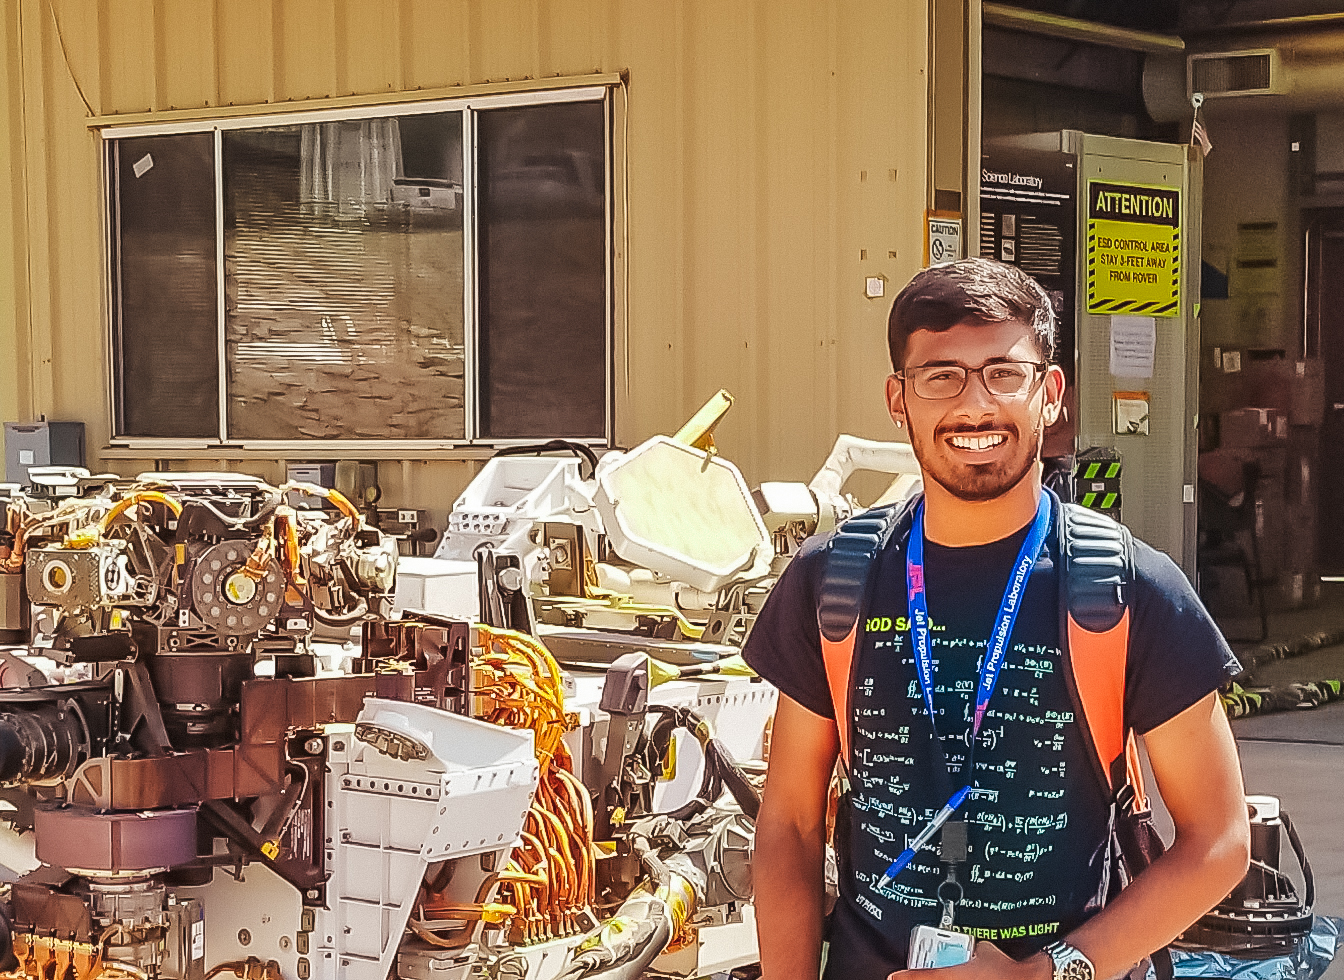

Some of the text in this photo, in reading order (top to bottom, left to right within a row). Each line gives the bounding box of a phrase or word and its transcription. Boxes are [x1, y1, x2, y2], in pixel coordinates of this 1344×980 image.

[1008, 172, 1043, 189] Laboratory
[1096, 191, 1173, 218] ATTENTION
[931, 223, 958, 236] CAUTION
[1097, 237, 1170, 254] ESD CONTROL AREA
[1100, 253, 1167, 269] STAY 3-FEET AWAY
[1109, 270, 1158, 284] FROM ROVER
[895, 616, 946, 632] SD...
[915, 609, 925, 625] Jet
[983, 555, 1032, 690] Jet Propulsion Laboratory
[917, 628, 931, 684] Propulsion
[962, 926, 998, 940] THERE
[999, 926, 1027, 939] WAS
[1028, 921, 1060, 936] LIGHT
